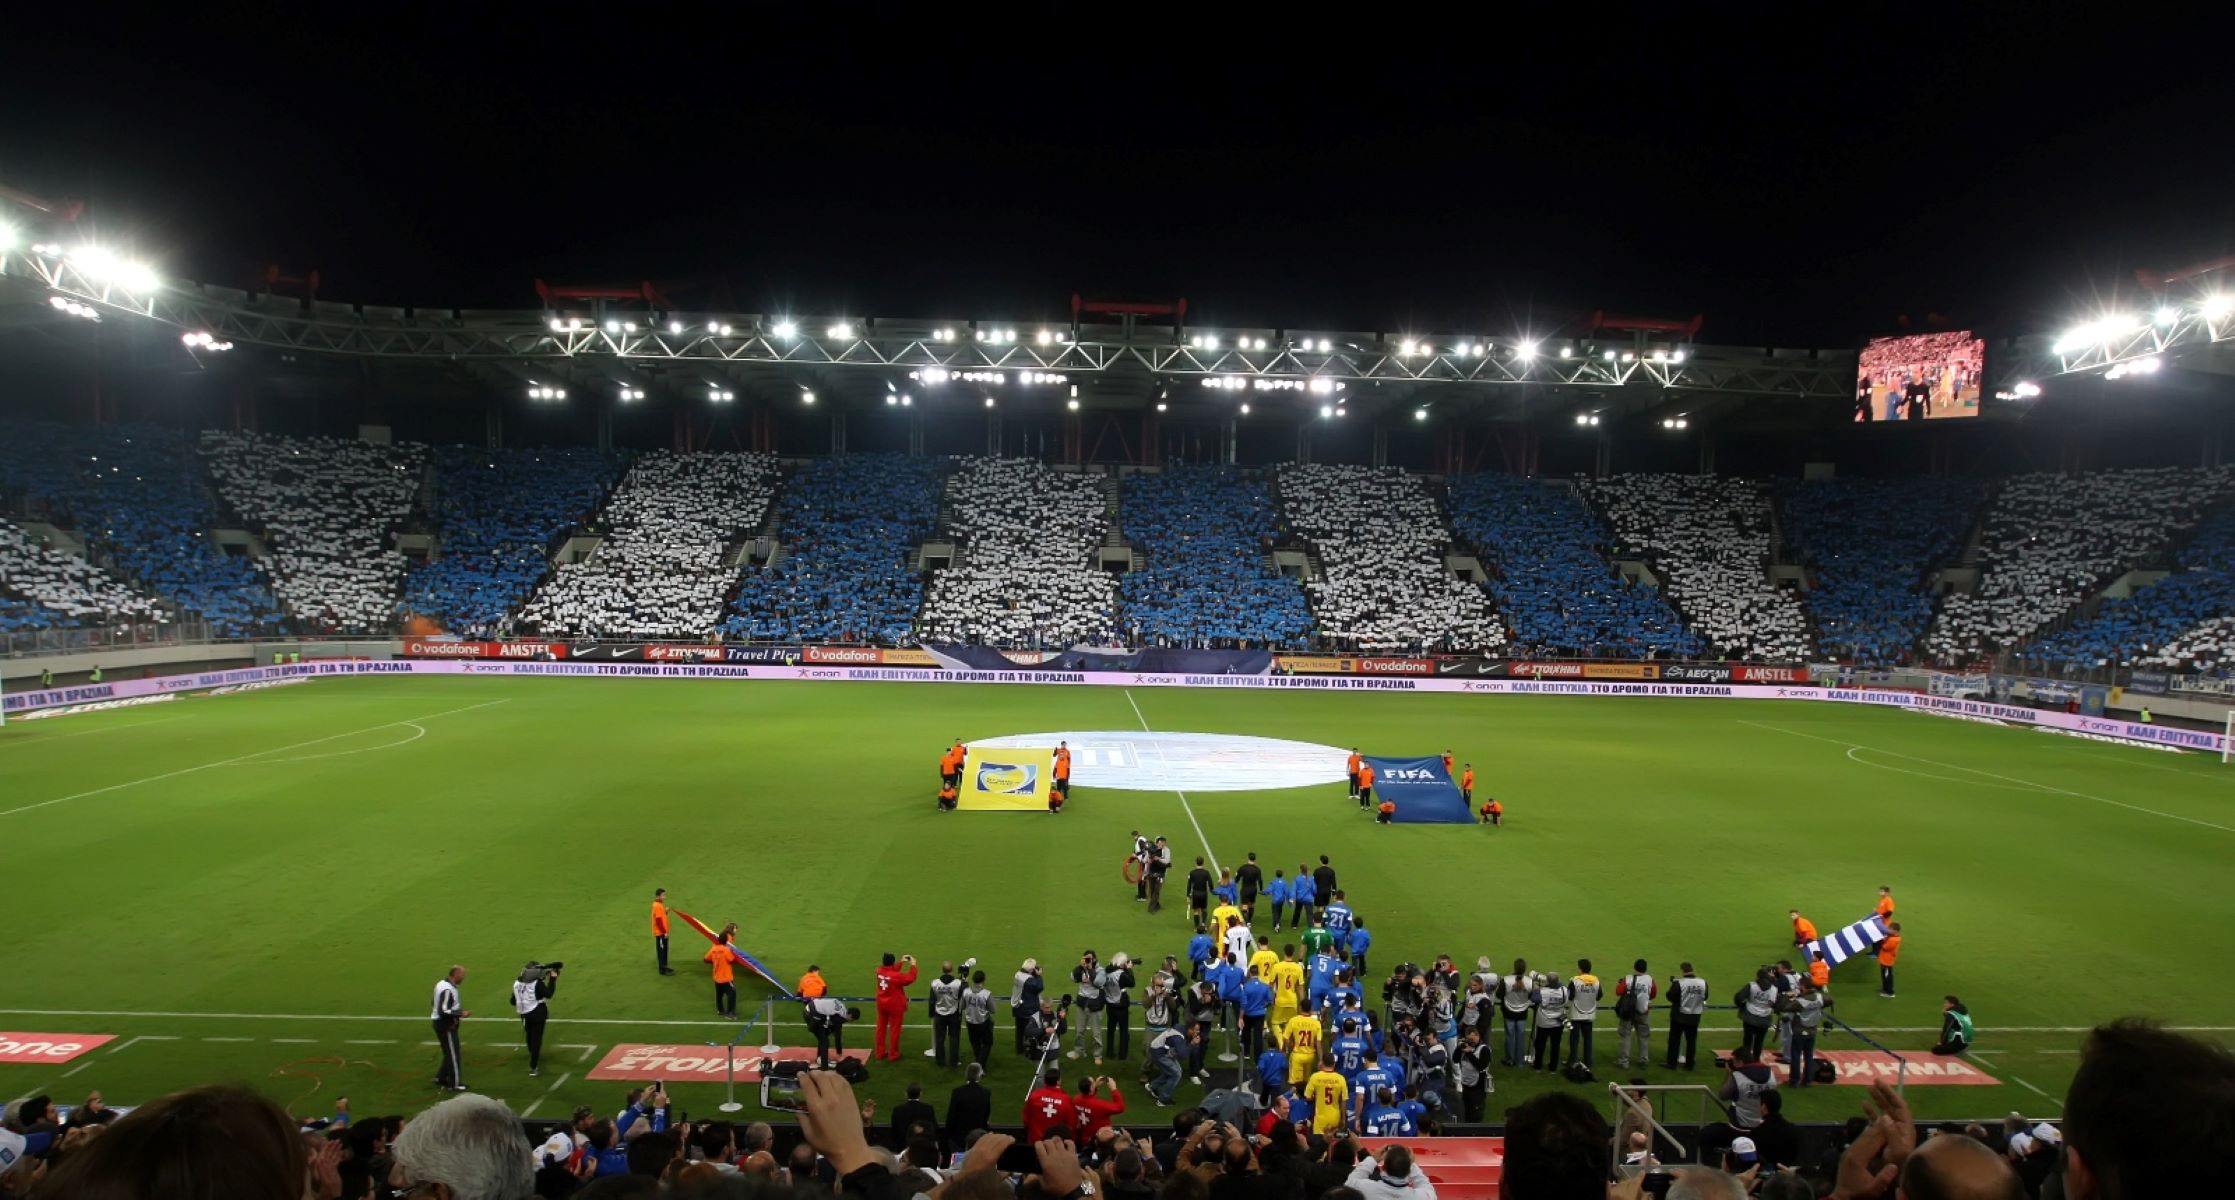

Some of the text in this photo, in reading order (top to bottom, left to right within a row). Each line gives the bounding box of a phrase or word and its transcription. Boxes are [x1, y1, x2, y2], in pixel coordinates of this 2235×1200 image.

[423, 644, 480, 654] vodafone
[728, 649, 768, 660] Travel
[820, 650, 876, 661] vodafone
[597, 665, 617, 674] ΣΤΟ
[620, 666, 659, 675] ΔΡΟΜΟ
[663, 666, 680, 675] ΓΙΑ
[681, 667, 696, 676] ΤΗ
[700, 667, 749, 677] ΒΡΑΖΙΛΙΑ
[1375, 661, 1427, 672] vodafone
[848, 670, 879, 679] ΚΑΛΗ
[934, 672, 952, 680] ΣΤΟ
[956, 672, 994, 681] ΔΡΟΜΟ
[998, 672, 1016, 681] ΓΙΑ
[1018, 672, 1032, 682] ΤΗ
[1035, 673, 1084, 682] ΒΡΑΖΙΛΙΑ
[1744, 669, 1794, 681] AMSTEL
[1185, 676, 1214, 685] ΚΑΛΗ
[1267, 678, 1286, 686] ΣΤΟ
[1289, 678, 1328, 688] ΔΡΟΜΟ
[1332, 679, 1348, 688] ΓΙΑ
[1351, 679, 1364, 688] ΤΗ
[1366, 680, 1416, 689] ΒΡΑΖΙΛΙΑ
[1512, 682, 1540, 692] ΚΑΛΗ
[1591, 684, 1610, 693] ΣΤΟ
[1612, 684, 1649, 694] ΔΡΟΜΟ
[1652, 686, 1668, 694] ΓΙΑ
[1670, 686, 1682, 694] ΤΗ
[1685, 686, 1732, 696] ΒΡΑΖΙΛΙΑ
[1964, 702, 1978, 712] ΓΙΑ
[1384, 769, 1435, 779] FIFA
[1330, 912, 1344, 928] 21
[1236, 936, 1242, 951] 1
[1318, 958, 1328, 972] 5
[1286, 974, 1292, 990] 6
[1298, 1030, 1312, 1046] 21
[0, 1037, 83, 1056] one
[605, 1056, 775, 1073] ΣΤΟΙΧ
[1342, 1050, 1360, 1070] 15
[1776, 1060, 1976, 1078] ΙΧΗΜΑ
[1324, 1088, 1332, 1105] 5
[1380, 1122, 1399, 1138] 14
